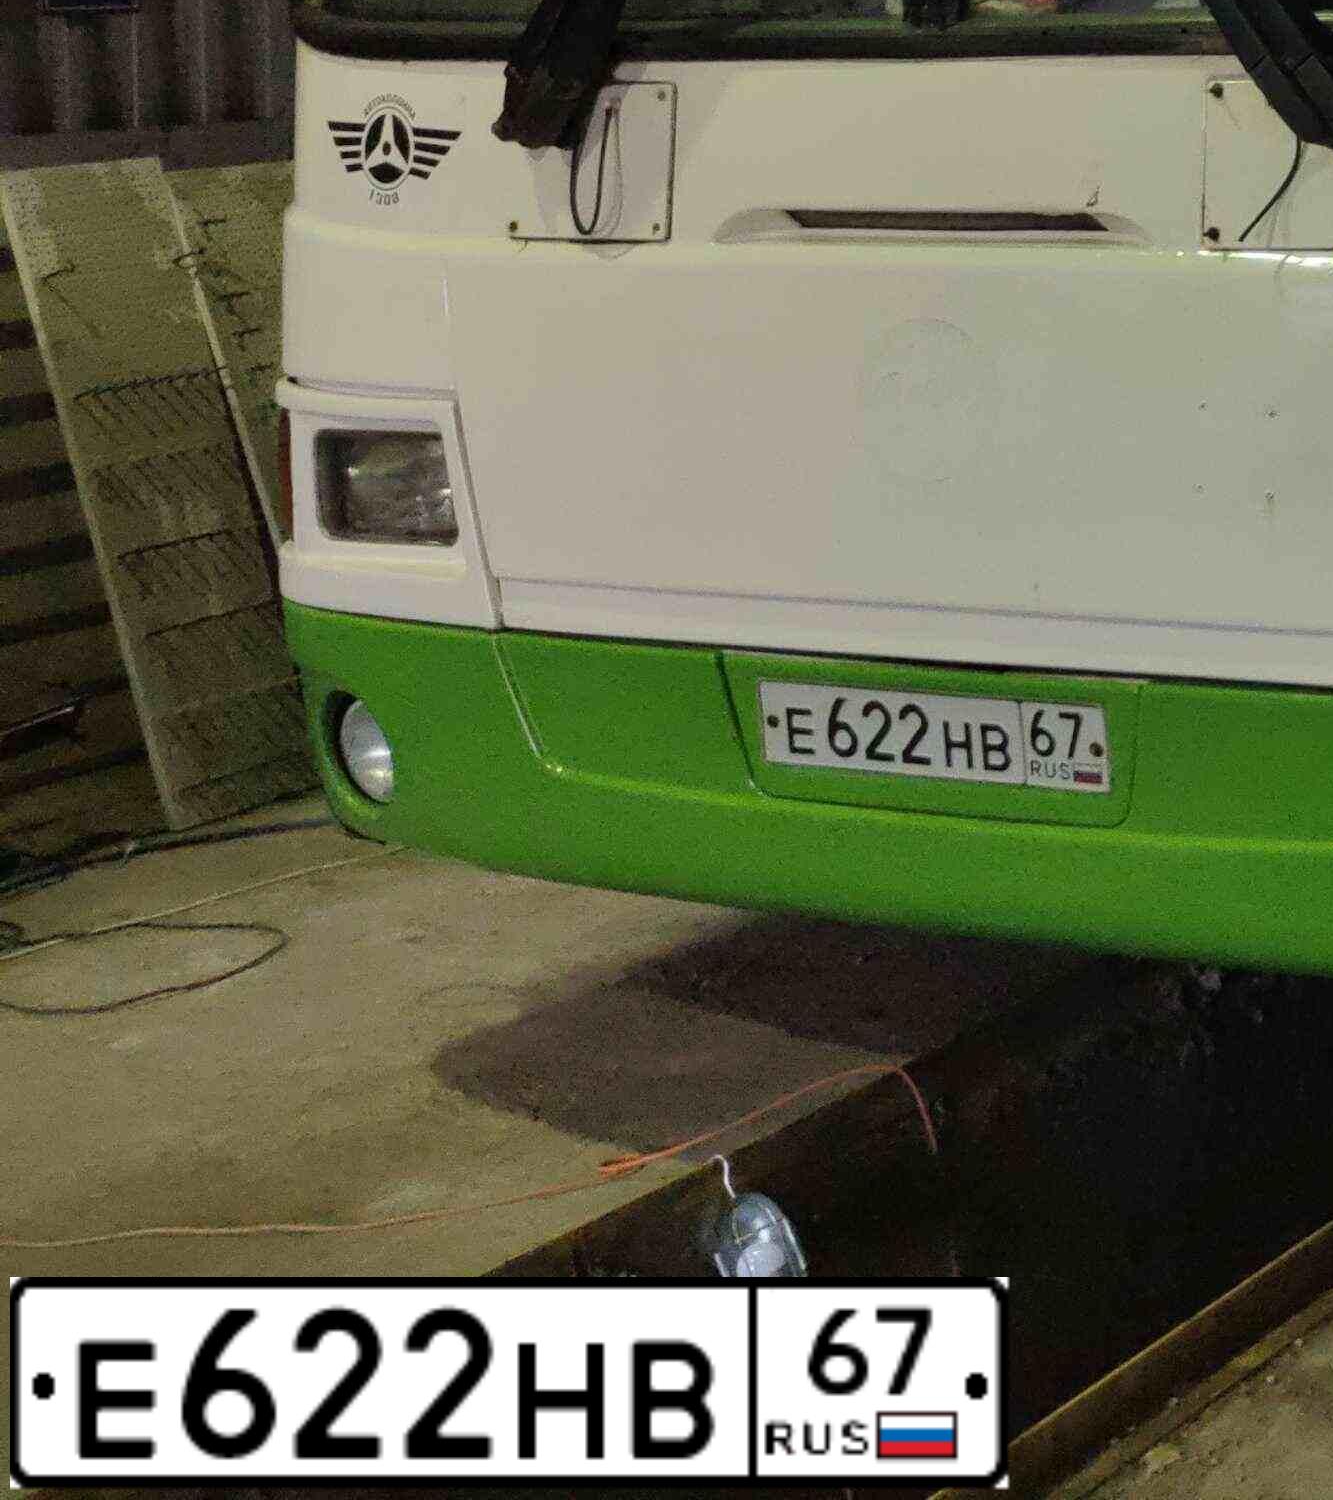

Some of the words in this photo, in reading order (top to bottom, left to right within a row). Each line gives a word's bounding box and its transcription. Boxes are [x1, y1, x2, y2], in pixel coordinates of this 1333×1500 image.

[785, 697, 1012, 771] Е622НВ
[1030, 708, 1083, 759] 67
[1030, 760, 1071, 780] RUS
